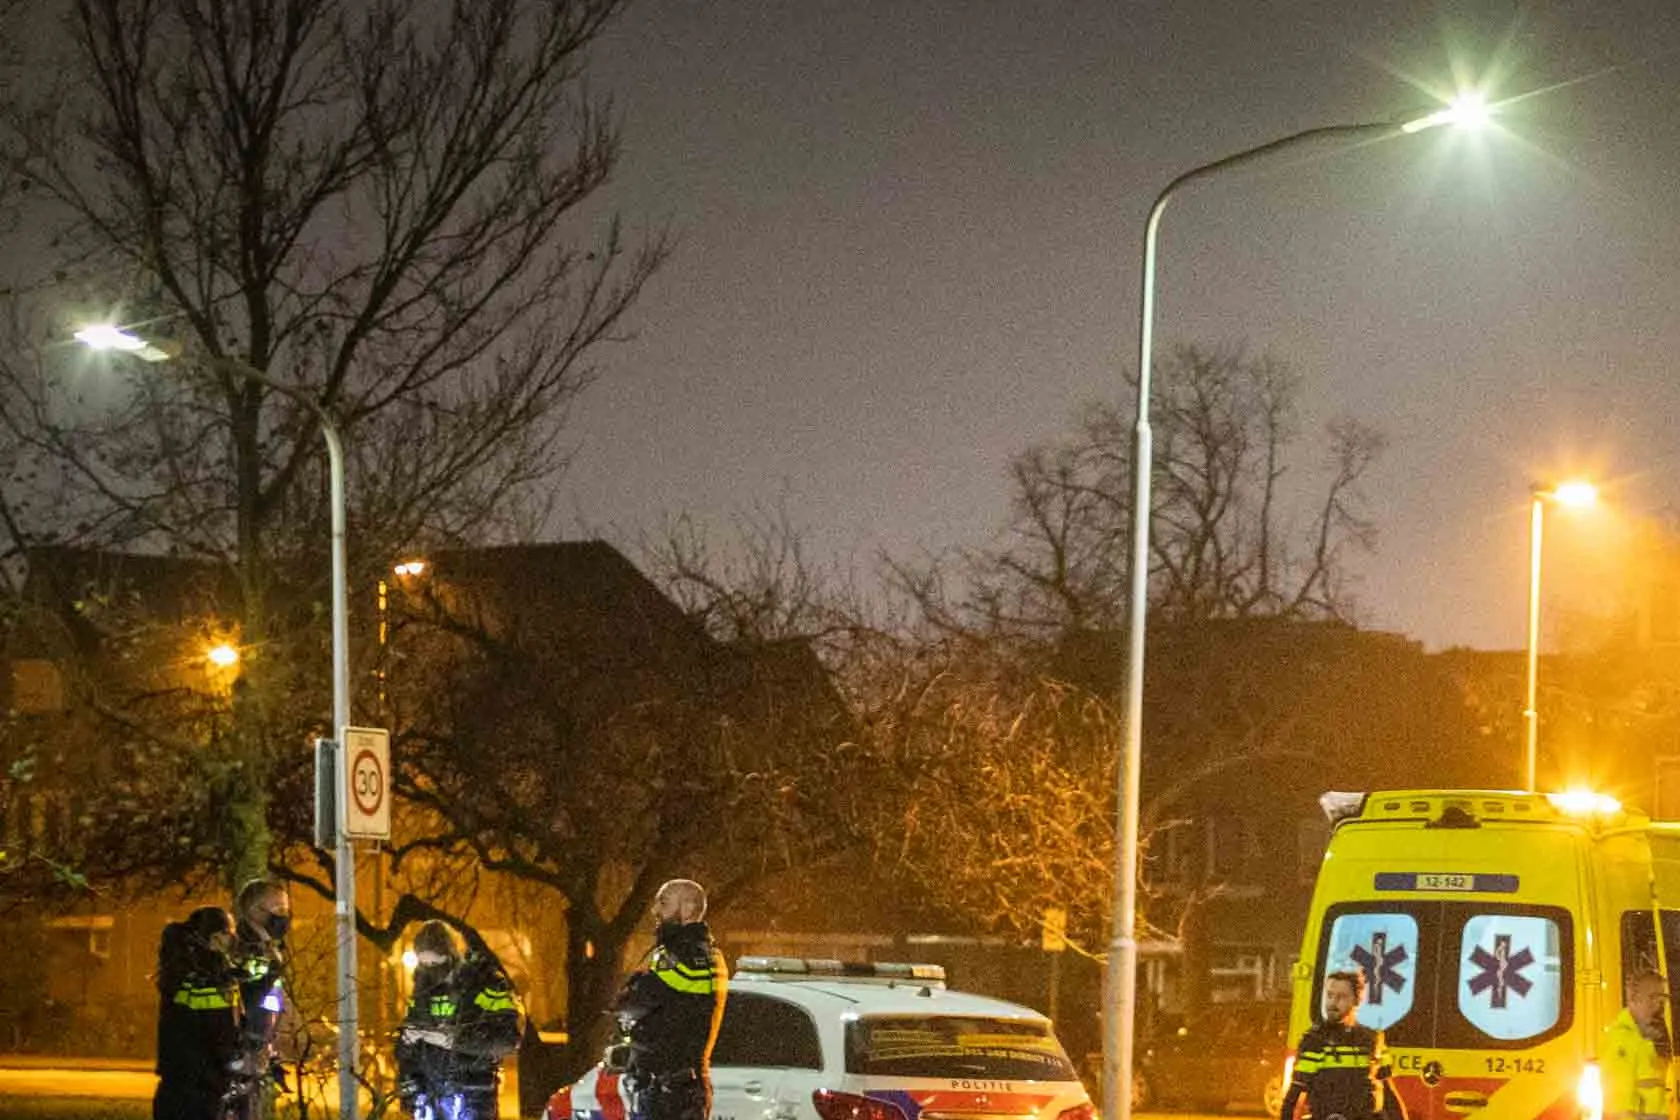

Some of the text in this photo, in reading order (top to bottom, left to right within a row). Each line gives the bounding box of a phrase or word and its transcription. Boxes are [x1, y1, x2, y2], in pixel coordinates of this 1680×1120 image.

[358, 769, 378, 797] 30
[1485, 1057, 1545, 1074] 12-142
[951, 1080, 1012, 1092] POLITIE
